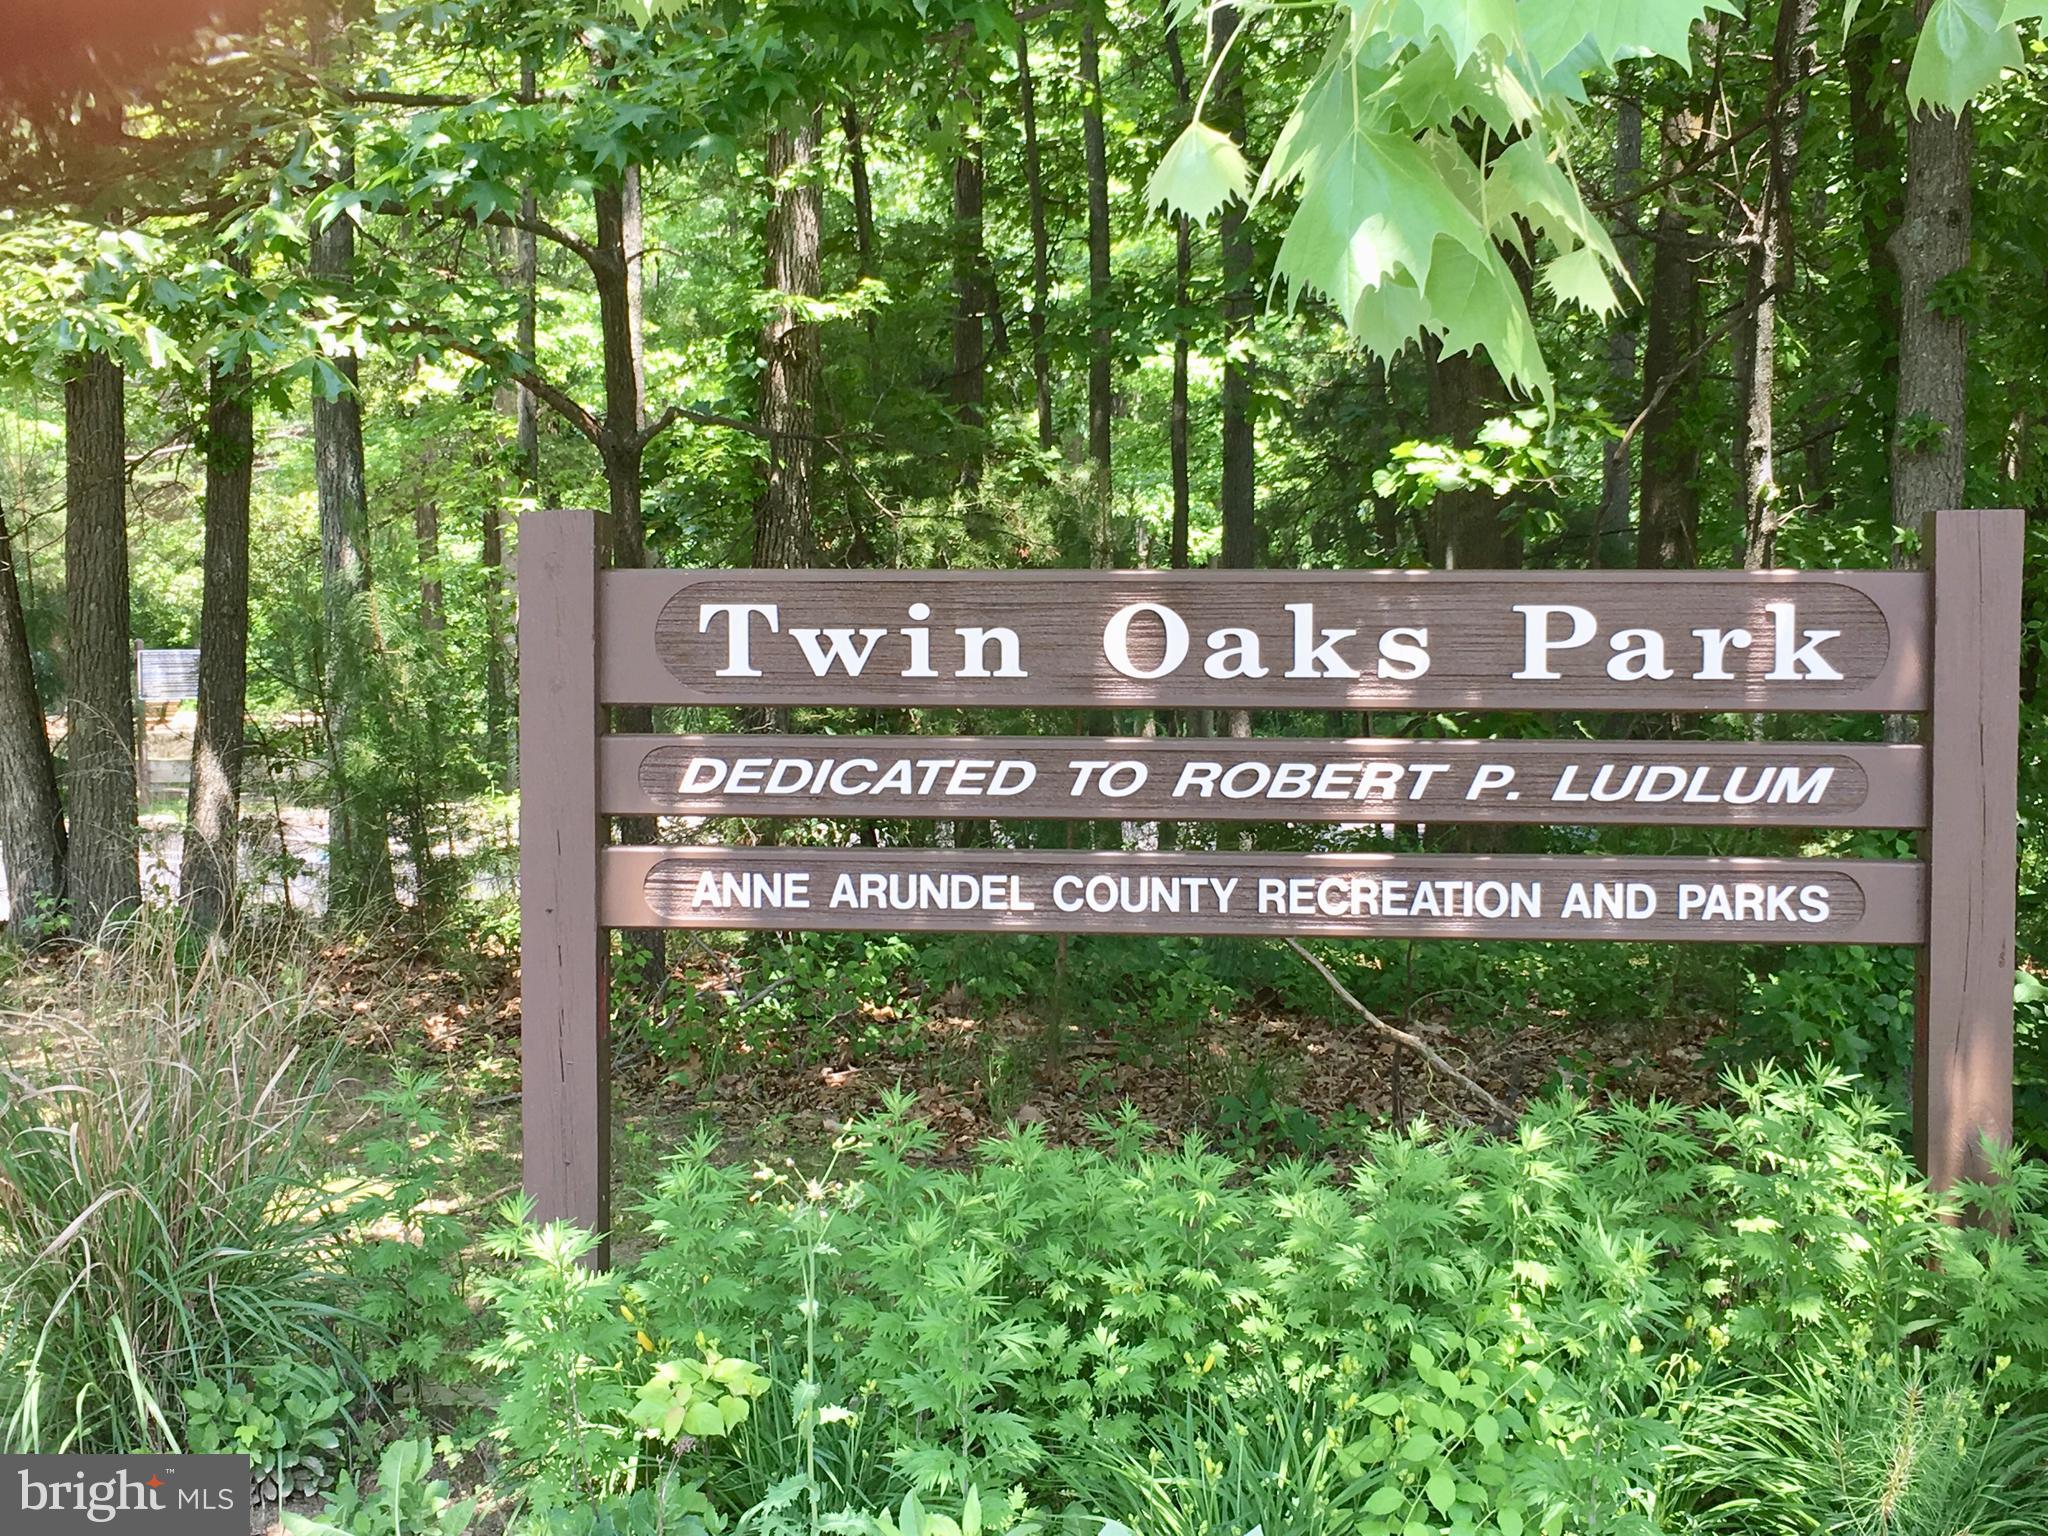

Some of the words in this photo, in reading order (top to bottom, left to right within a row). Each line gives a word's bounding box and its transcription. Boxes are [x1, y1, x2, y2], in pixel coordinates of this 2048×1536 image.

[699, 603, 1028, 679] Twin
[1103, 603, 1431, 680] Oaks
[1512, 603, 1845, 681] Park
[678, 758, 1036, 797] DEDICATED
[1070, 760, 1148, 799] TO
[1172, 760, 1449, 802] ROBERT
[1466, 763, 1521, 801] P.
[1552, 764, 1834, 805] LUDLUM
[692, 872, 811, 909] ANNE
[830, 873, 1035, 912] ARUNDEL
[1053, 875, 1239, 914] COUNTY
[1258, 878, 1542, 918] RECREATION
[1561, 882, 1657, 920] AND
[1678, 884, 1831, 923] PARKS
